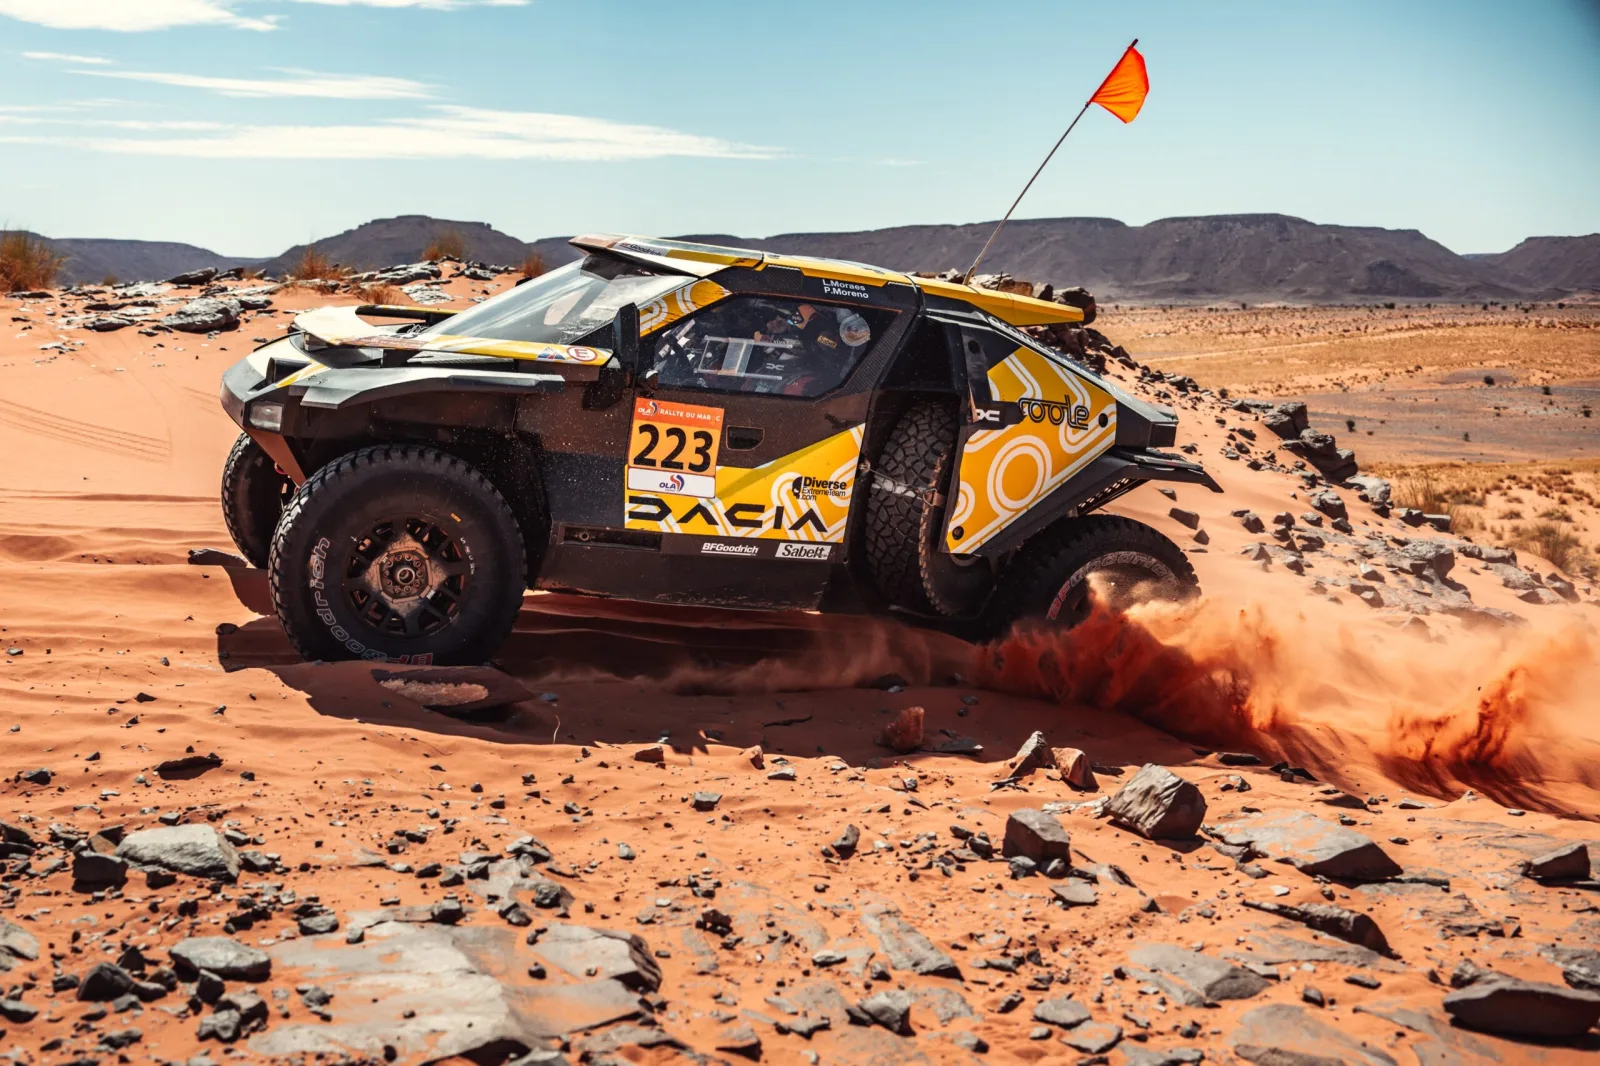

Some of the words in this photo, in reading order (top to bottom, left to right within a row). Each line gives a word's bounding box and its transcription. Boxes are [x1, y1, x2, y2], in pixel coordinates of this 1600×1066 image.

[822, 278, 866, 291] L.Moraes
[823, 286, 869, 299] P.Moreno
[659, 408, 684, 418] RALLYE
[633, 423, 714, 474] 223
[659, 481, 676, 491] OLA
[803, 476, 847, 490] Diverse
[801, 486, 846, 497] ExtremeTeam
[628, 495, 829, 533] DACIA
[701, 542, 760, 554] BFGoodrich
[782, 544, 825, 559] Sabelt
